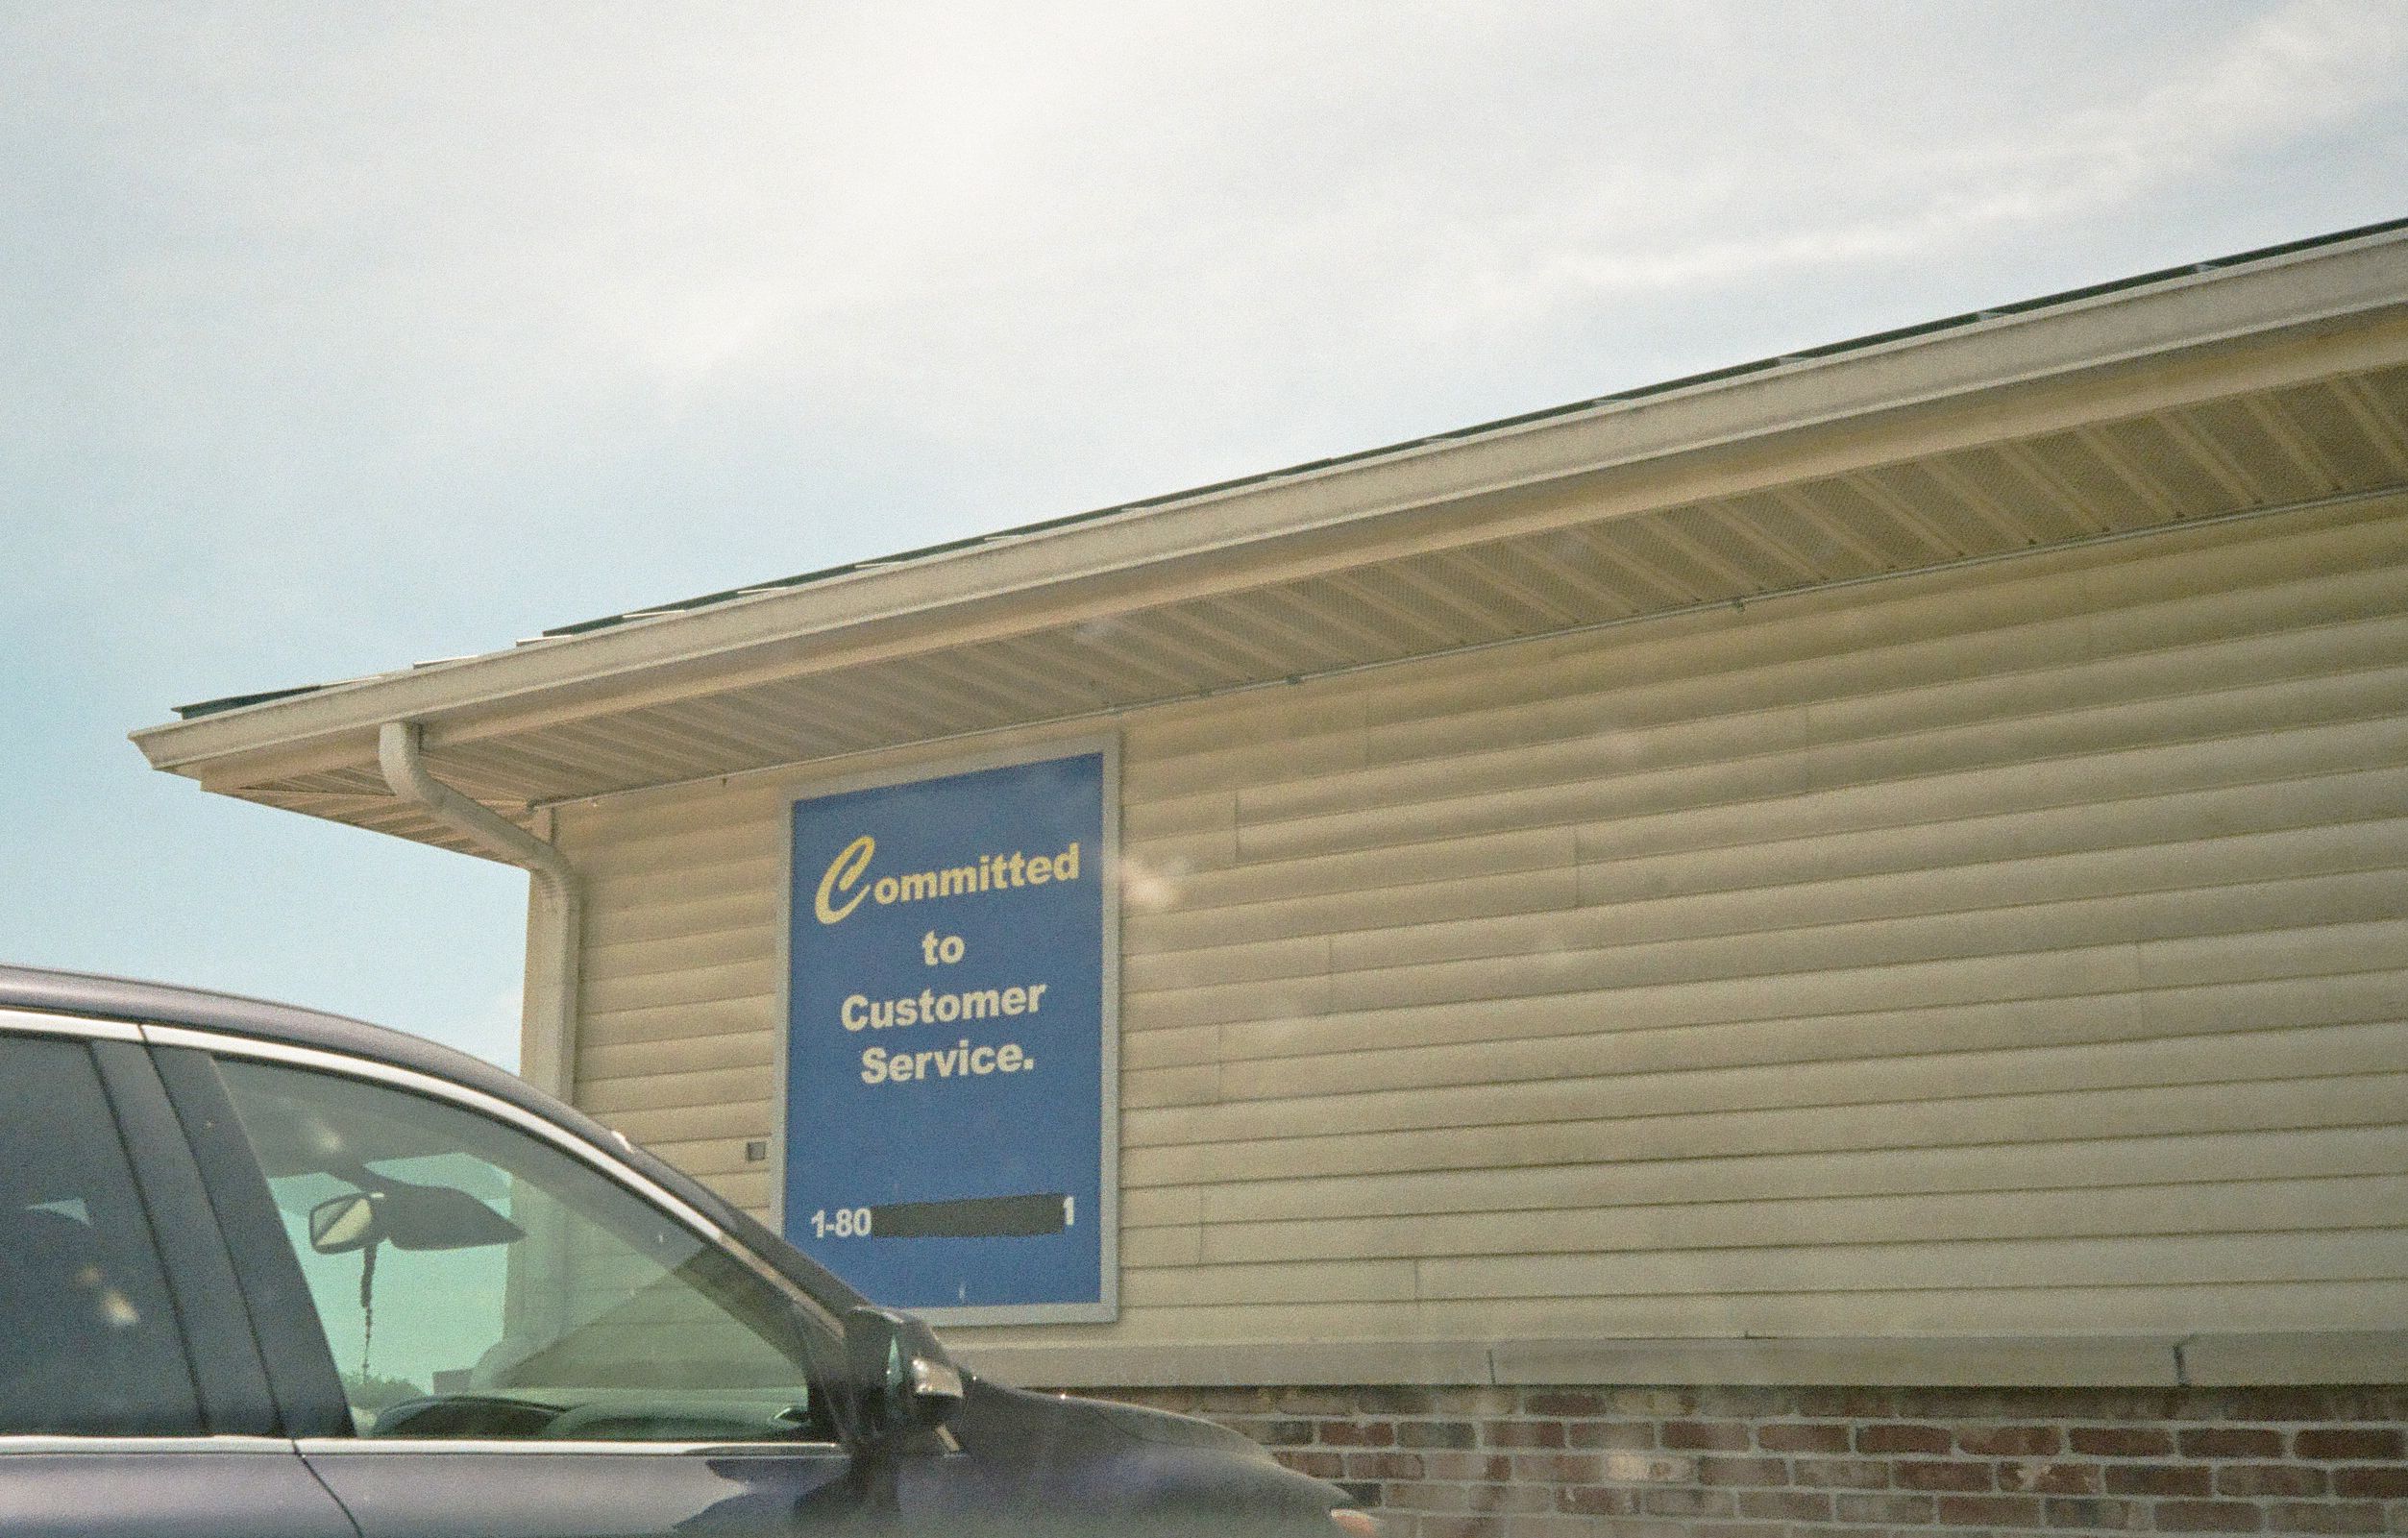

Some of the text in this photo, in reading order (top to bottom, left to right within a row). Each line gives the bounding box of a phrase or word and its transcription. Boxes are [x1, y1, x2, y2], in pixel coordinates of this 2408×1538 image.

[815, 835, 1080, 925] Committed
[921, 930, 966, 966] to
[841, 984, 1047, 1032] Customer
[861, 1039, 1035, 1085] Service.
